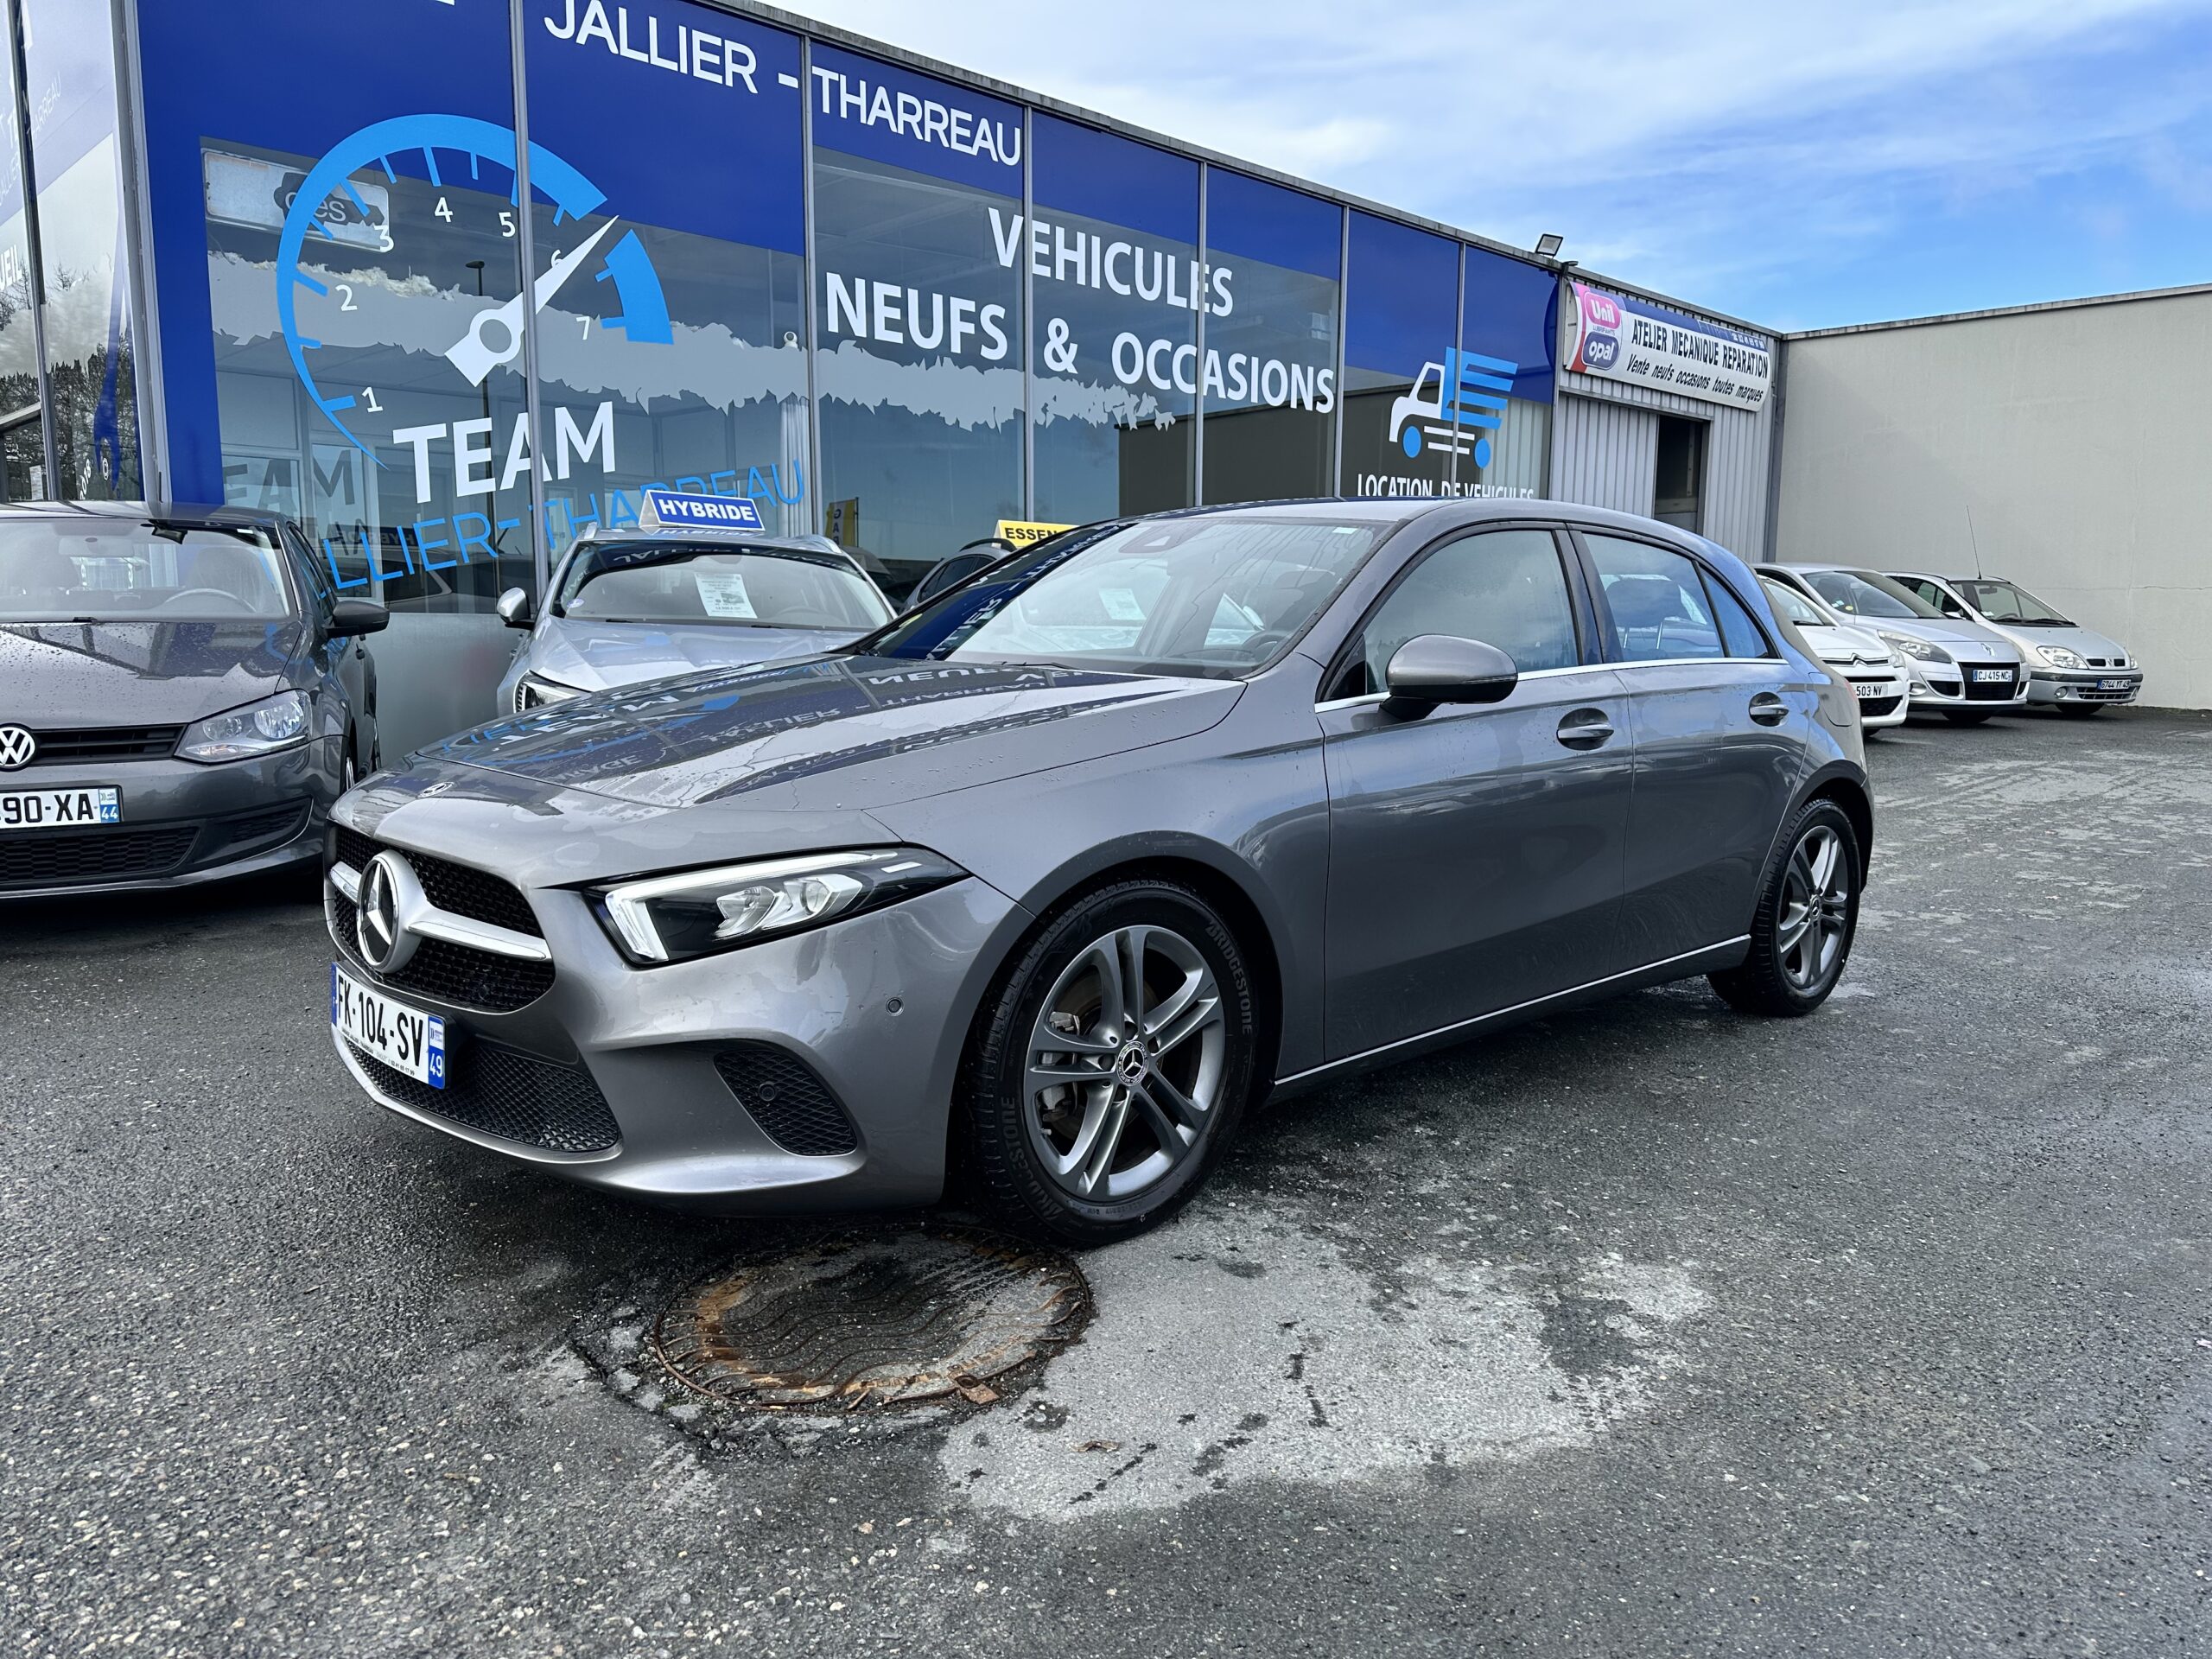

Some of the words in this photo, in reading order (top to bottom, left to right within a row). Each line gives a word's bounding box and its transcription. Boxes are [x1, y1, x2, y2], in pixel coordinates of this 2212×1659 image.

[544, 0, 758, 94] JALLIER
[812, 65, 1021, 166] THARREAU
[435, 197, 454, 222] 4
[374, 225, 395, 252] 3
[499, 212, 516, 238] 5
[988, 207, 1233, 317] VEHICULES
[337, 284, 358, 311] 2
[1590, 299, 1615, 324] Unil
[576, 316, 590, 340] 7
[826, 272, 1007, 360] NEUFS
[1043, 317, 1078, 373] &
[1111, 332, 1334, 414] OCCASIONS
[1588, 340, 1616, 362] opal
[1631, 319, 1668, 353] ATELIER
[1671, 329, 1719, 366] MECANIQUE
[1722, 345, 1768, 379] REPARATION
[1626, 353, 1650, 376] Vente
[1651, 363, 1675, 382] neufs
[1675, 370, 1711, 390] occasions
[1712, 376, 1735, 395] toutes
[1735, 385, 1764, 404] marques
[361, 386, 384, 413] 1
[392, 401, 616, 504] TEAM
[1357, 474, 1433, 498] LOCATION
[658, 499, 756, 522] HYBRIDE
[101, 806, 118, 820] 44
[338, 974, 424, 1067] FK-104-SV
[429, 1052, 443, 1077] 49
